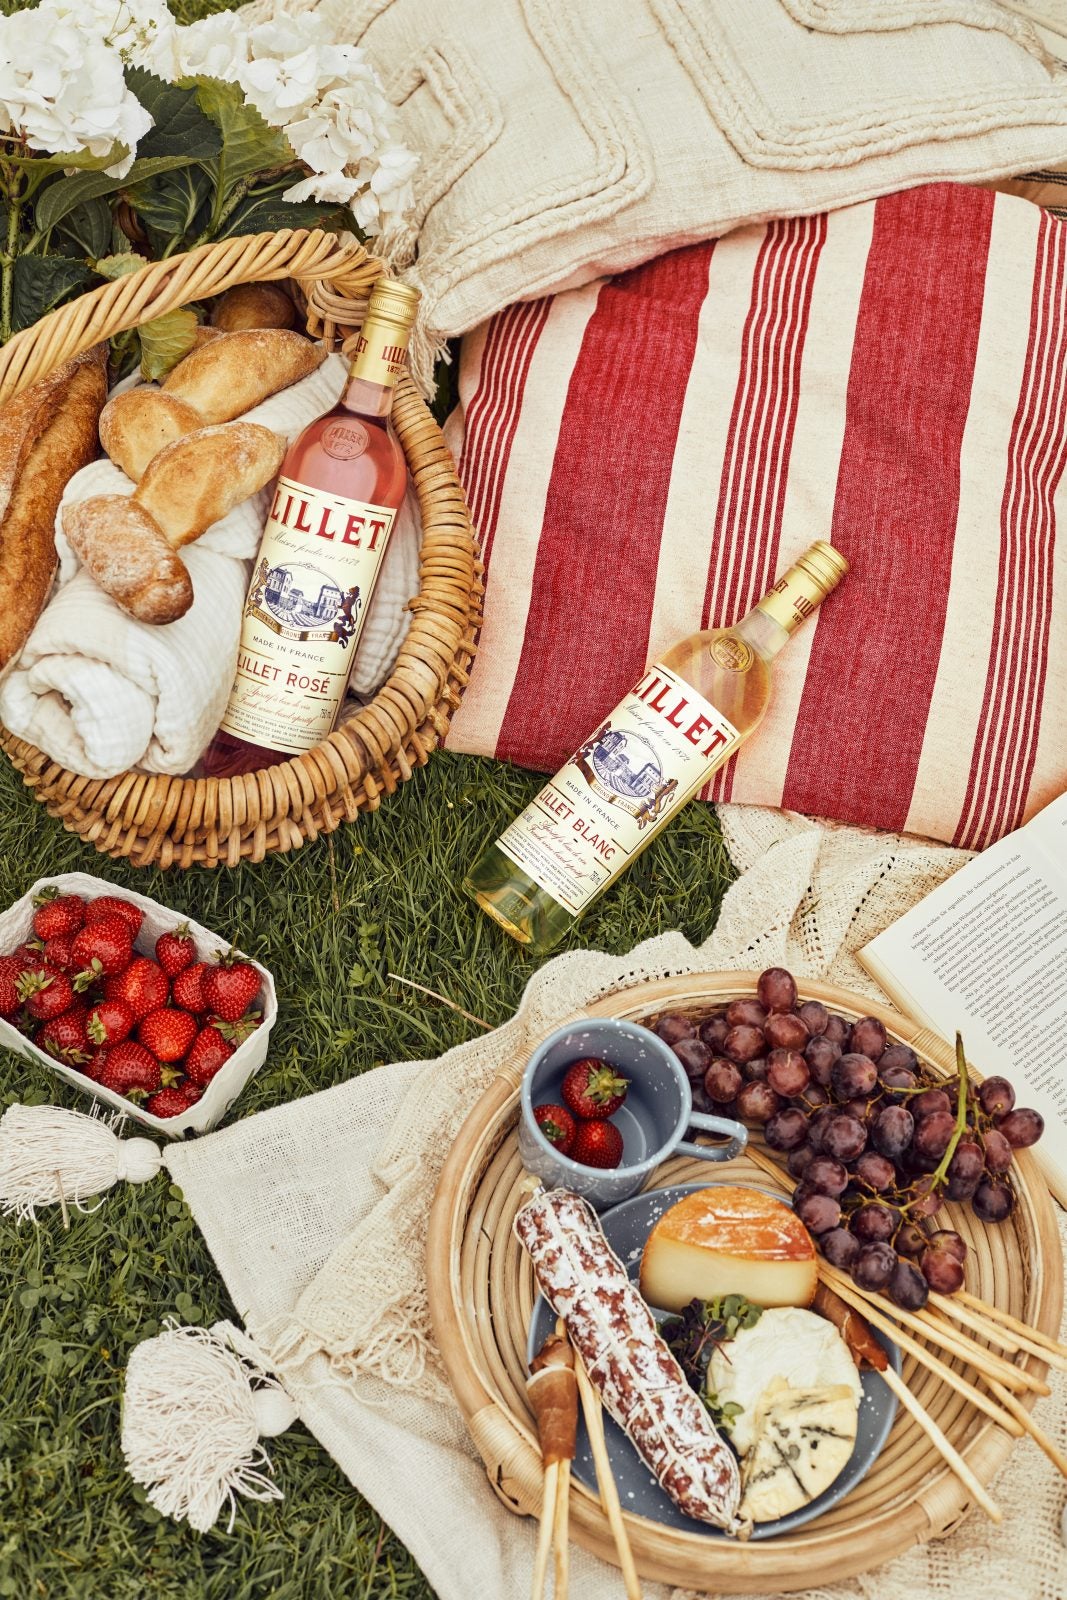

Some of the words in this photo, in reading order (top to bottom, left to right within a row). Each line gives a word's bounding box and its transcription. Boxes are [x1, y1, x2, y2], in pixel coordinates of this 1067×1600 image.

[270, 489, 386, 553] LILLET
[235, 653, 281, 681] LILLET
[286, 672, 330, 694] ROSÉ
[252, 635, 274, 649] MADE
[276, 644, 287, 652] IN
[288, 648, 325, 663] FRANCE
[631, 671, 728, 758] LILLET
[538, 788, 574, 820] LILLET
[571, 818, 617, 861] BLANC
[565, 780, 583, 796] MADE
[581, 795, 592, 805] IN
[591, 803, 621, 831] FRANCE
